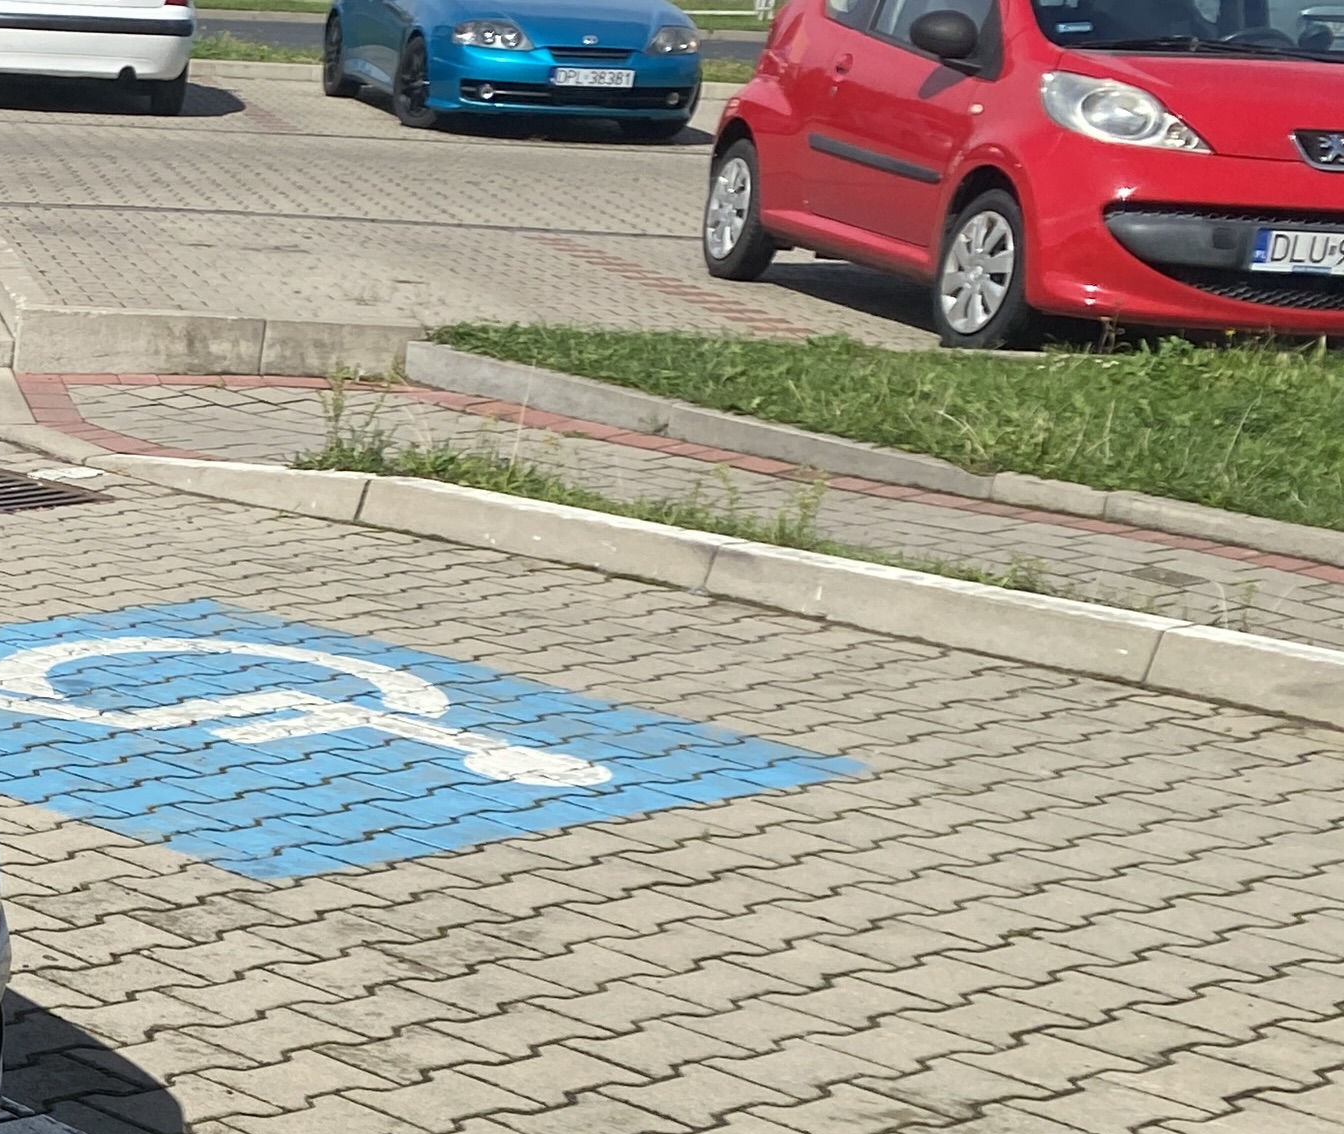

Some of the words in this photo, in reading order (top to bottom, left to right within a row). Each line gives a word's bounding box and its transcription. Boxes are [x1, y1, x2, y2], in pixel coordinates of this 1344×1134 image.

[556, 70, 583, 84] DPL
[588, 71, 631, 85] 38381
[1271, 234, 1330, 263] DLU
